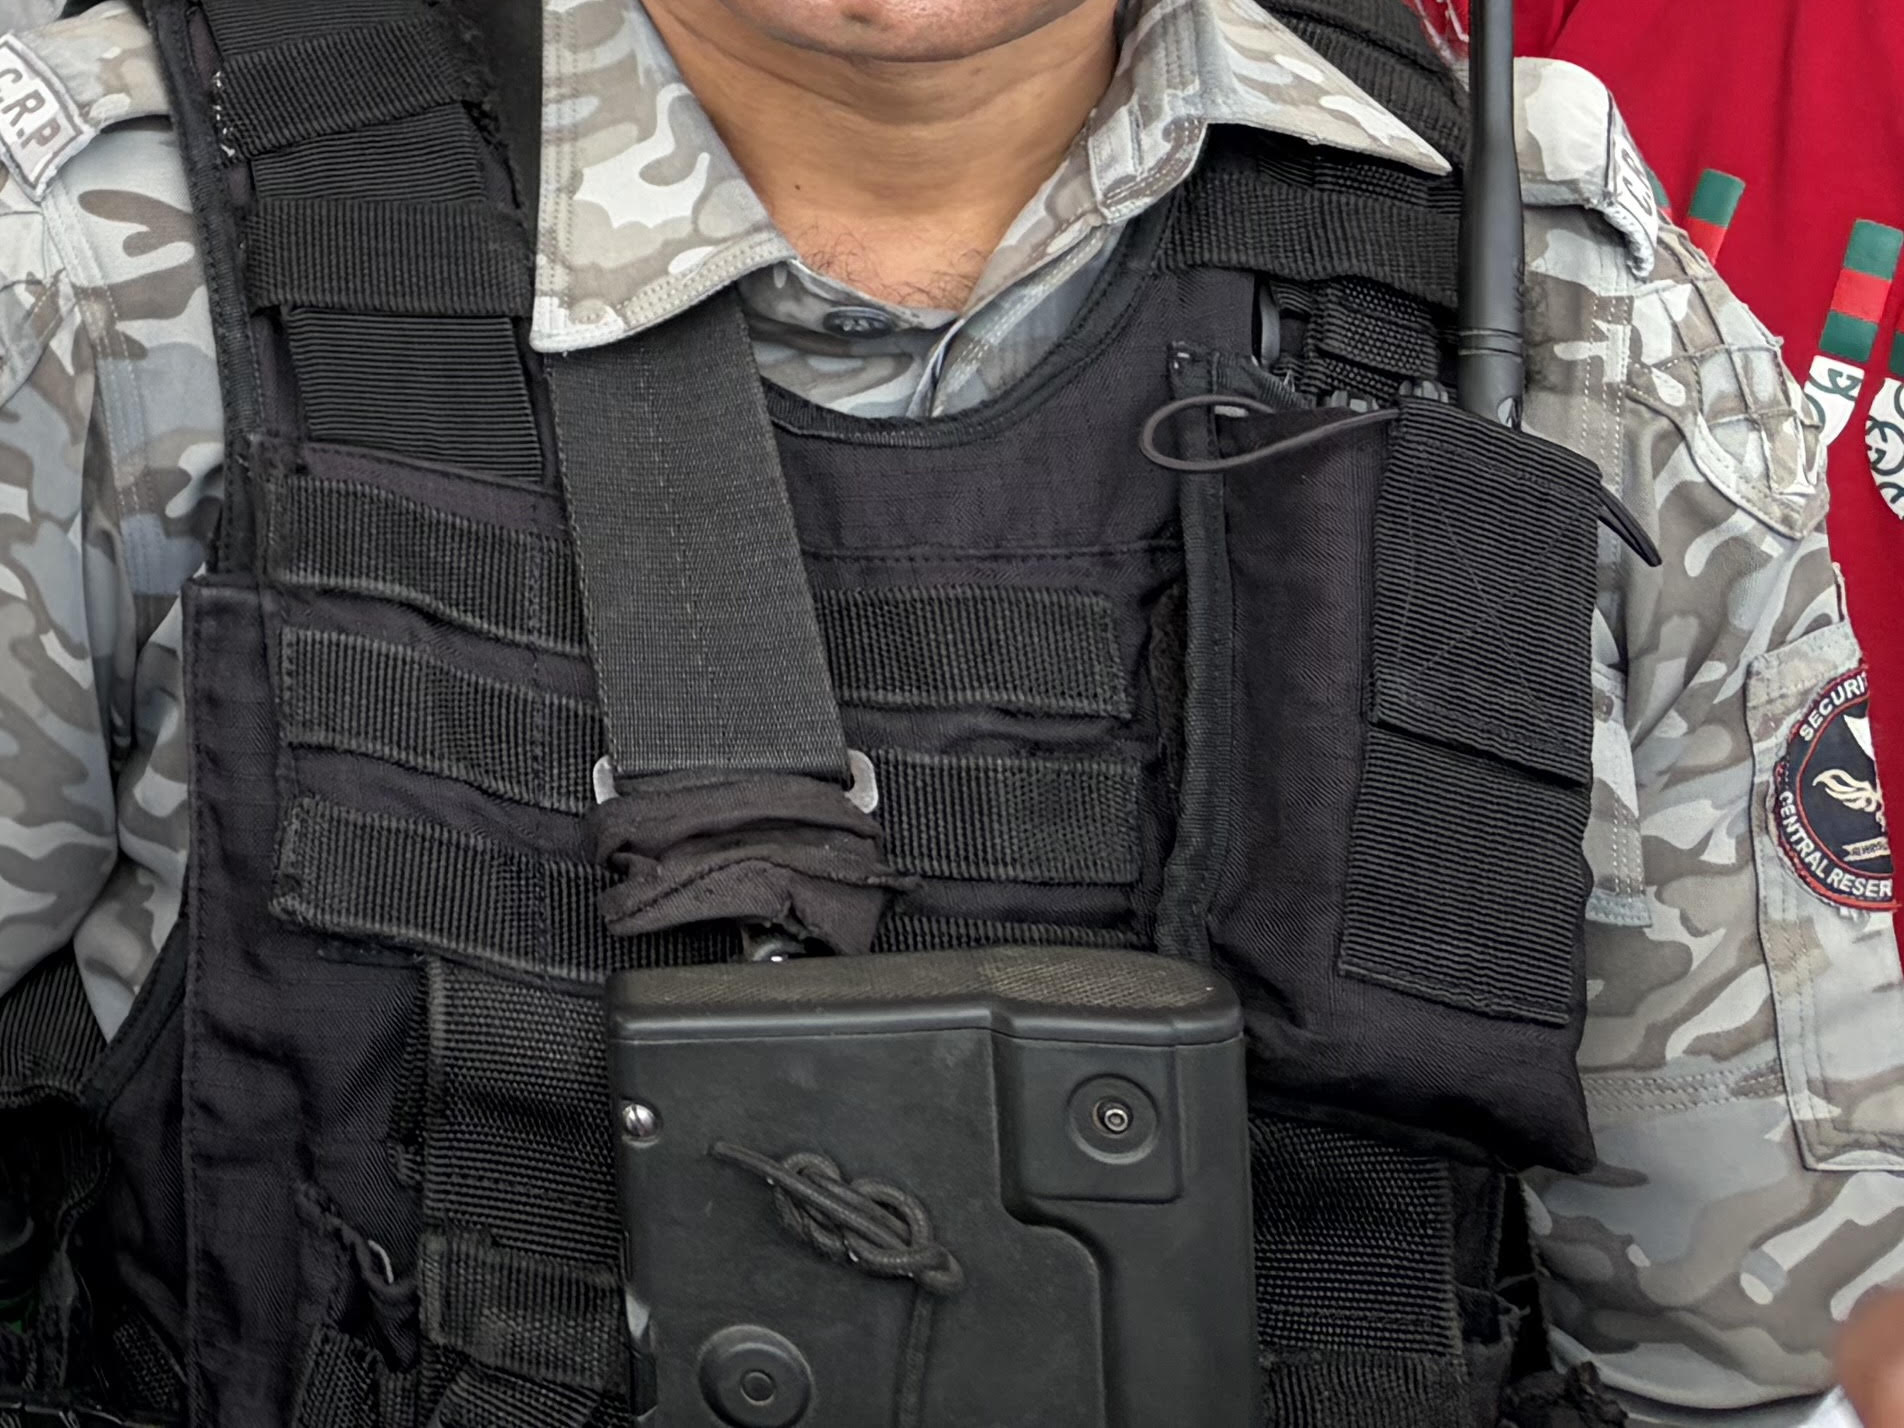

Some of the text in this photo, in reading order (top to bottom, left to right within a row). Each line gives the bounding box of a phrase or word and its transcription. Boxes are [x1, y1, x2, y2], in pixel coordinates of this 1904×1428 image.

[1798, 670, 1870, 743] SECURI
[1778, 790, 1893, 900] CENTRAL RESER
